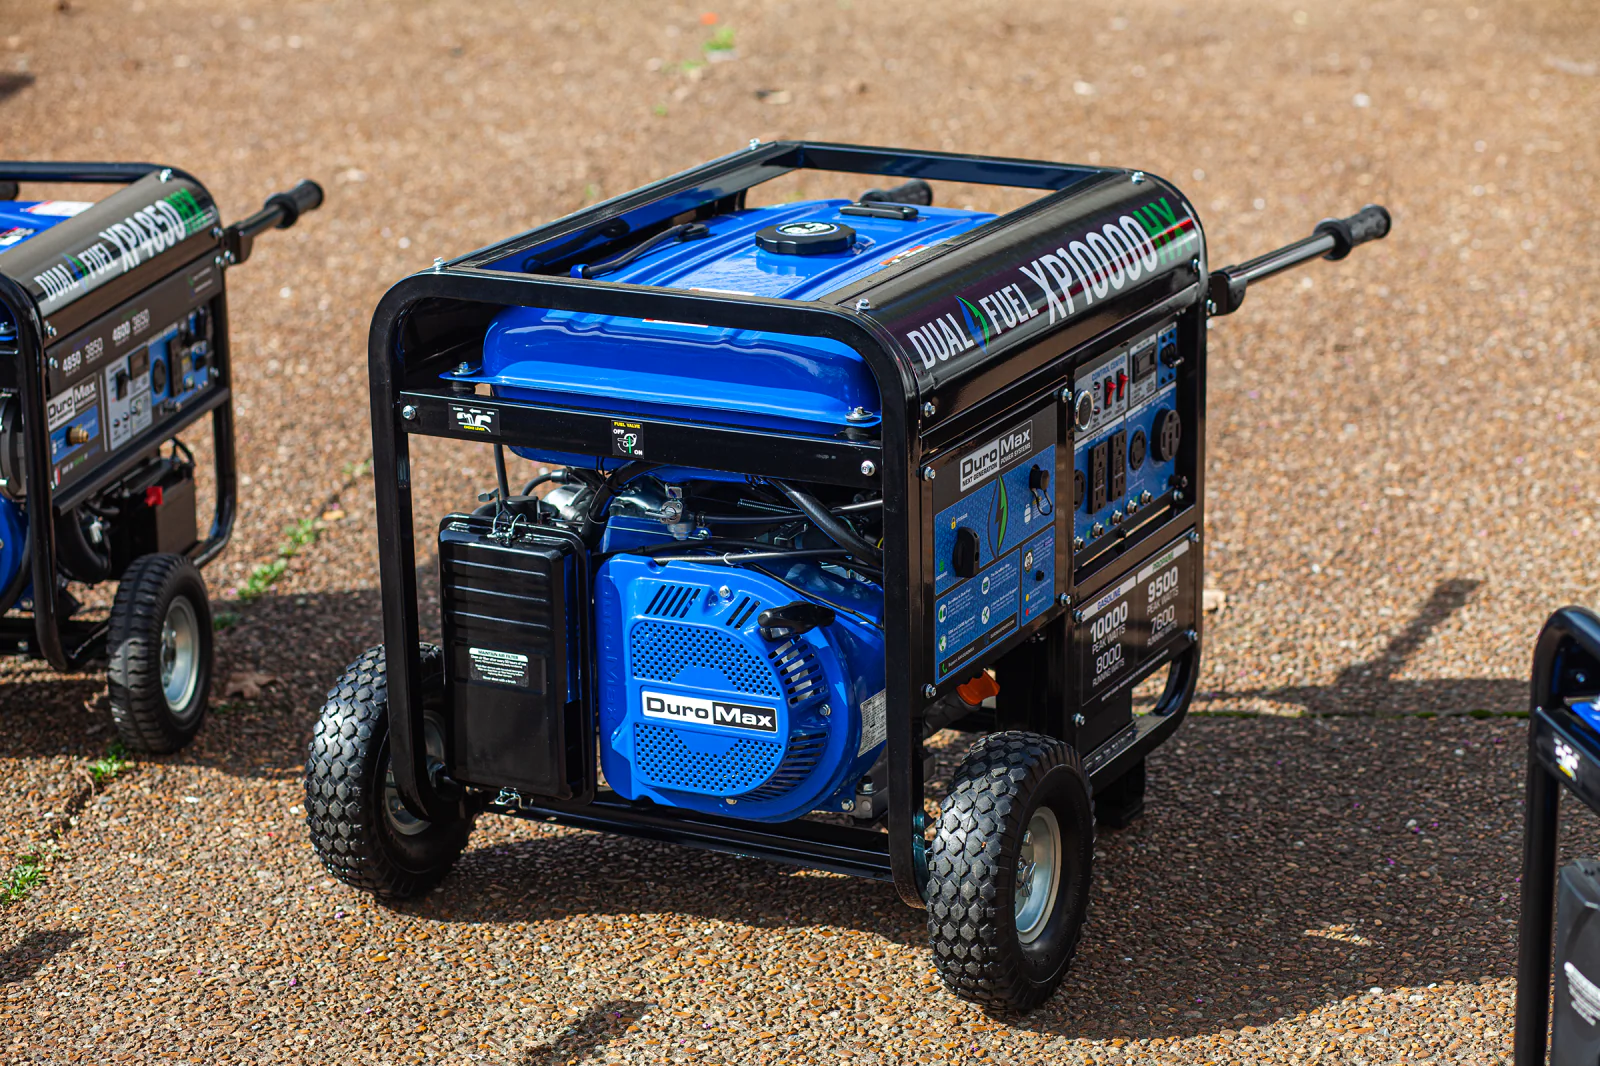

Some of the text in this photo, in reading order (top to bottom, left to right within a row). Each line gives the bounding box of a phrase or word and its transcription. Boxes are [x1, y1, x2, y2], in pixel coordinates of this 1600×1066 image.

[34, 263, 80, 302] DUAL
[77, 242, 118, 279] FUEL
[906, 312, 975, 370] DUAL
[978, 283, 1038, 335] FUEL
[1097, 587, 1121, 611] GASOLINE
[1148, 566, 1179, 603] 9500
[1090, 600, 1128, 643] 10000
[1150, 604, 1175, 635] 7600
[1092, 624, 1126, 655] PEAK WATTS
[1096, 643, 1122, 675] 8000
[646, 696, 773, 728] DuroMax
